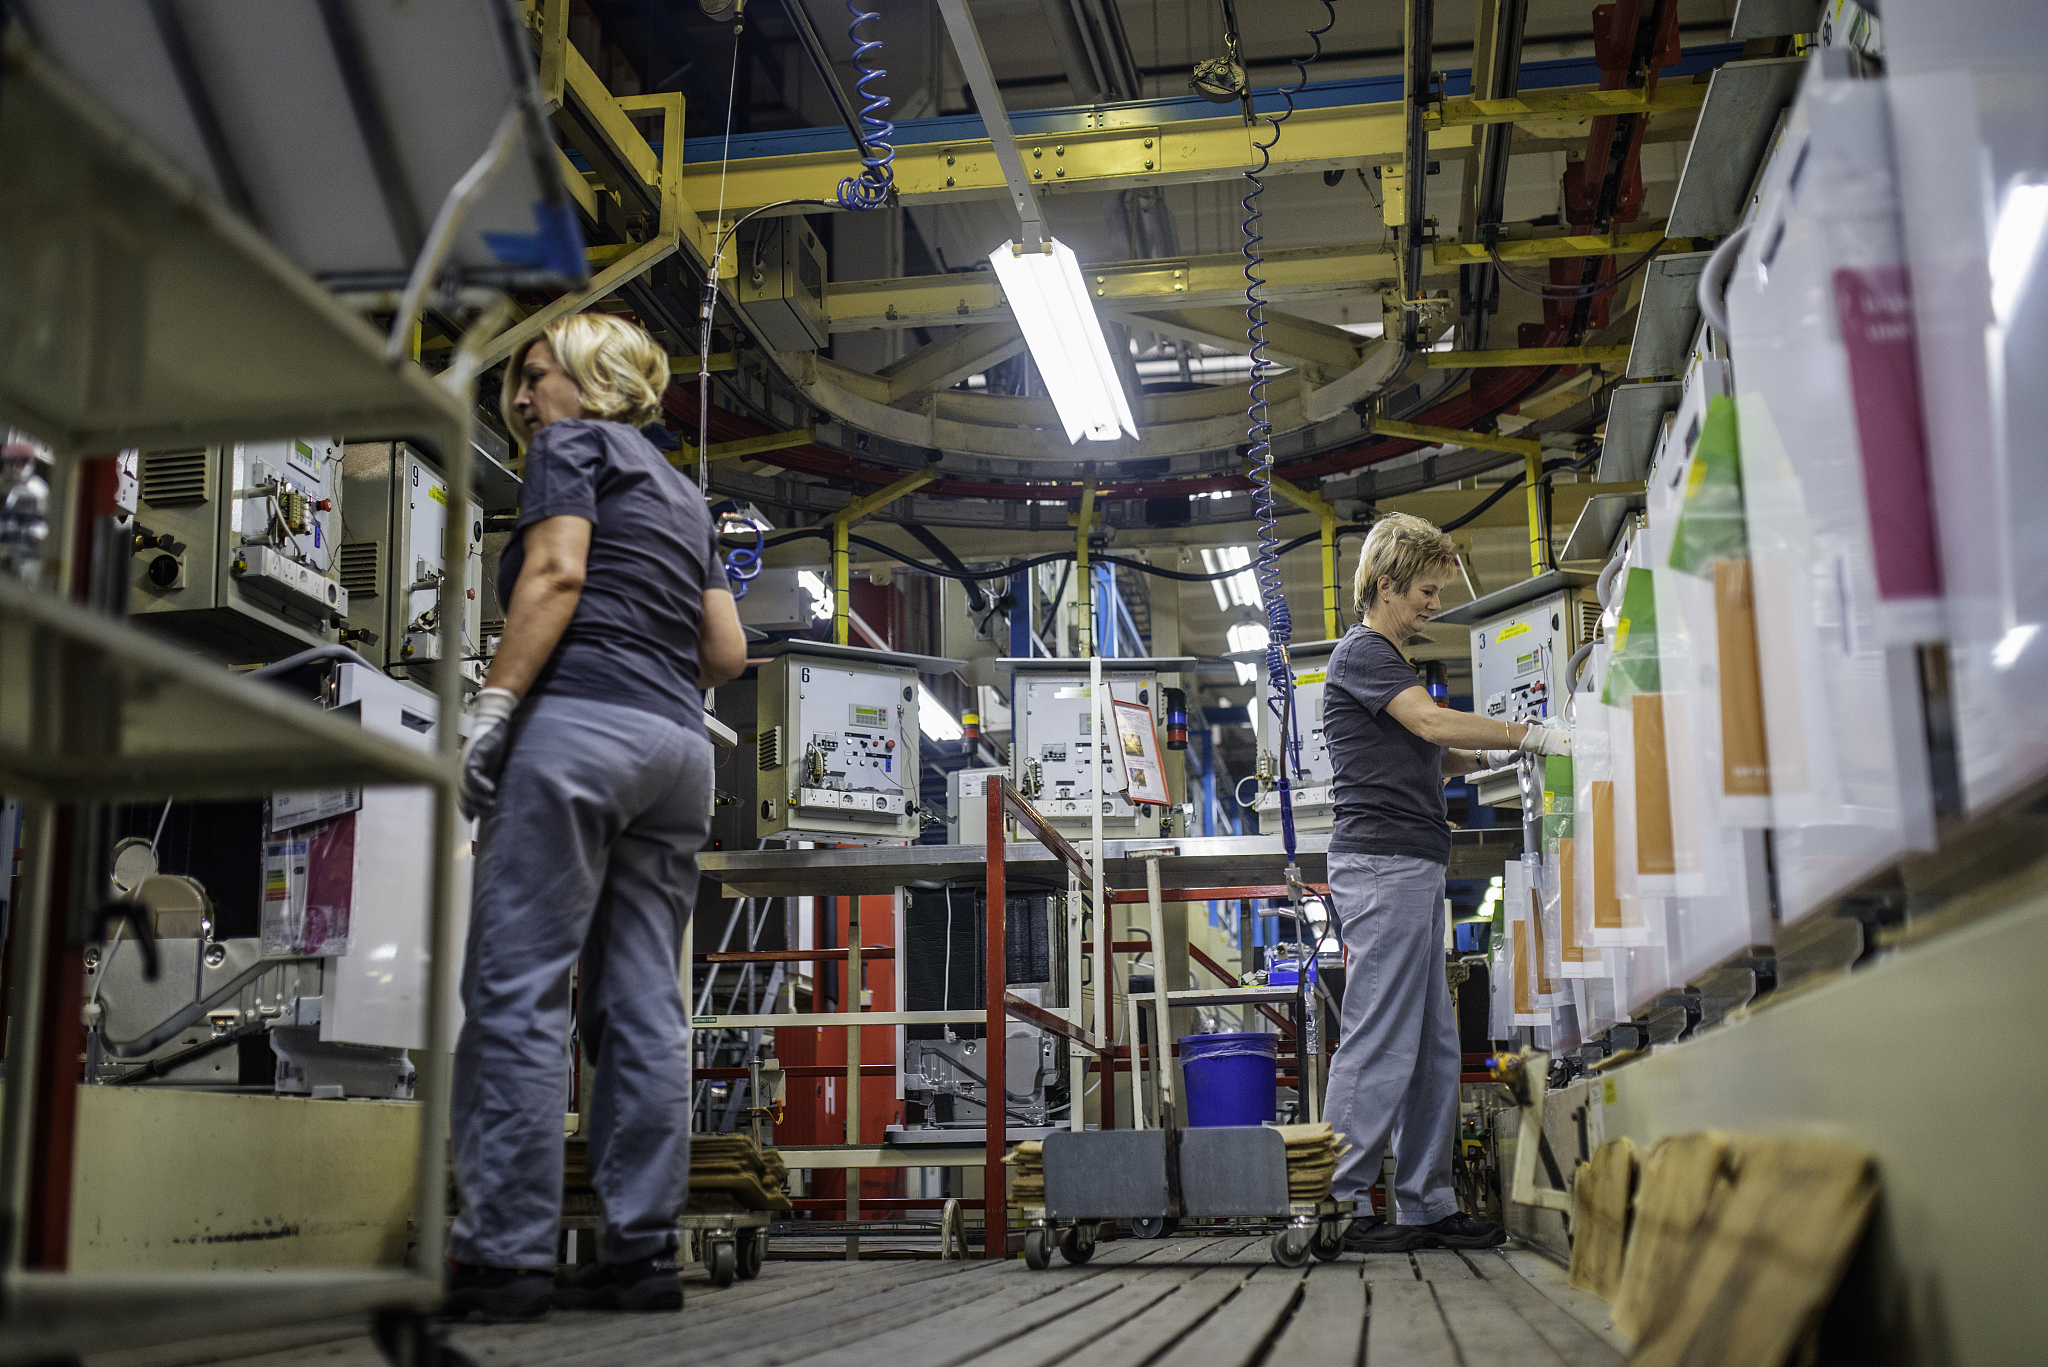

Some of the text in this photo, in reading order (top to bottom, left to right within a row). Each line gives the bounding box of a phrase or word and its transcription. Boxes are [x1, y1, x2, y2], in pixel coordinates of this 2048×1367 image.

[413, 465, 419, 487] 9
[1479, 633, 1486, 649] 3
[801, 667, 810, 683] 6
